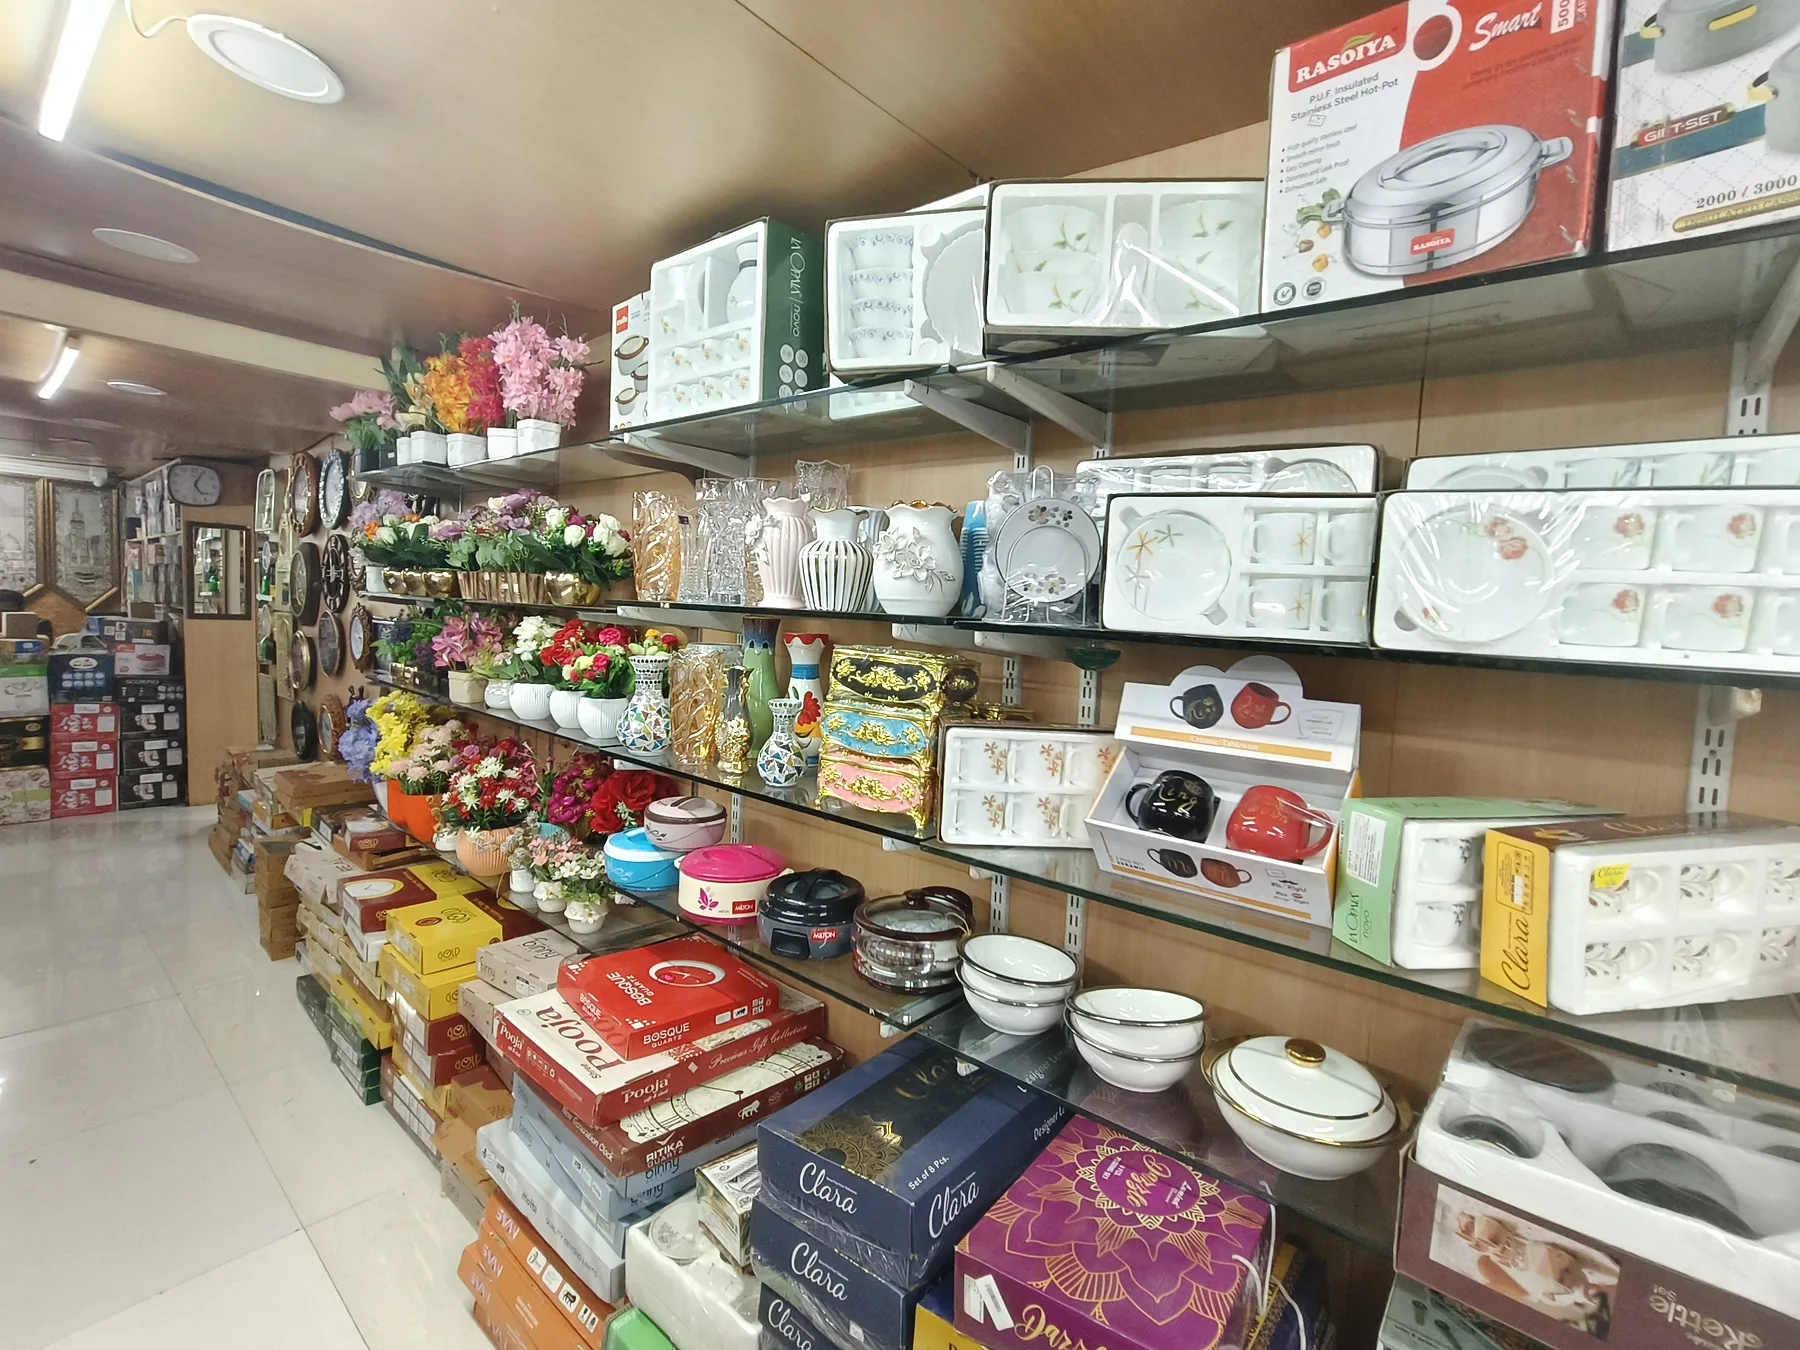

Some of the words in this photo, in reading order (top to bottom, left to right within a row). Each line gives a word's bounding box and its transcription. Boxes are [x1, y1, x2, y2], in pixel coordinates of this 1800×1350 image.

[1468, 1, 1543, 52] Smart
[1296, 33, 1397, 84] RASOIYA
[1335, 72, 1379, 95] Insulated
[1290, 102, 1332, 122] Stainless
[1334, 91, 1359, 107] Steel
[1360, 78, 1399, 98] Hot-Pot
[1696, 189, 1736, 209] 2000
[1753, 174, 1798, 195] 3000
[1413, 235, 1451, 251] RASOIYA
[792, 304, 801, 337] novo
[734, 903, 754, 911] MILTON
[812, 930, 836, 939] MILTON
[1363, 910, 1371, 939] novo
[1501, 917, 1531, 991] Clara
[605, 971, 653, 1007] BOSQUE
[626, 974, 655, 997] QUARTZ
[580, 992, 602, 1019] BOSQUE
[499, 1024, 524, 1051] Pooja
[535, 1005, 626, 1072] Pooja
[643, 1022, 691, 1045] BOSQUE
[651, 1034, 683, 1049] QUARTZ
[708, 1048, 748, 1070] Precious
[748, 1036, 768, 1056] Gift
[770, 1025, 808, 1045] Collection
[623, 1077, 670, 1104] Pooja
[572, 1115, 599, 1148] Generation
[598, 1142, 614, 1163] Clock
[1033, 1111, 1059, 1141] Designer
[645, 1138, 685, 1162] RITIKA
[799, 1162, 858, 1215] Clara
[908, 1177, 922, 1191] Set
[920, 1169, 930, 1181] of
[1125, 1154, 1172, 1208] Dazzle
[928, 1182, 980, 1240] Clara
[790, 1241, 848, 1301] Clara
[1653, 1283, 1678, 1301] Set
